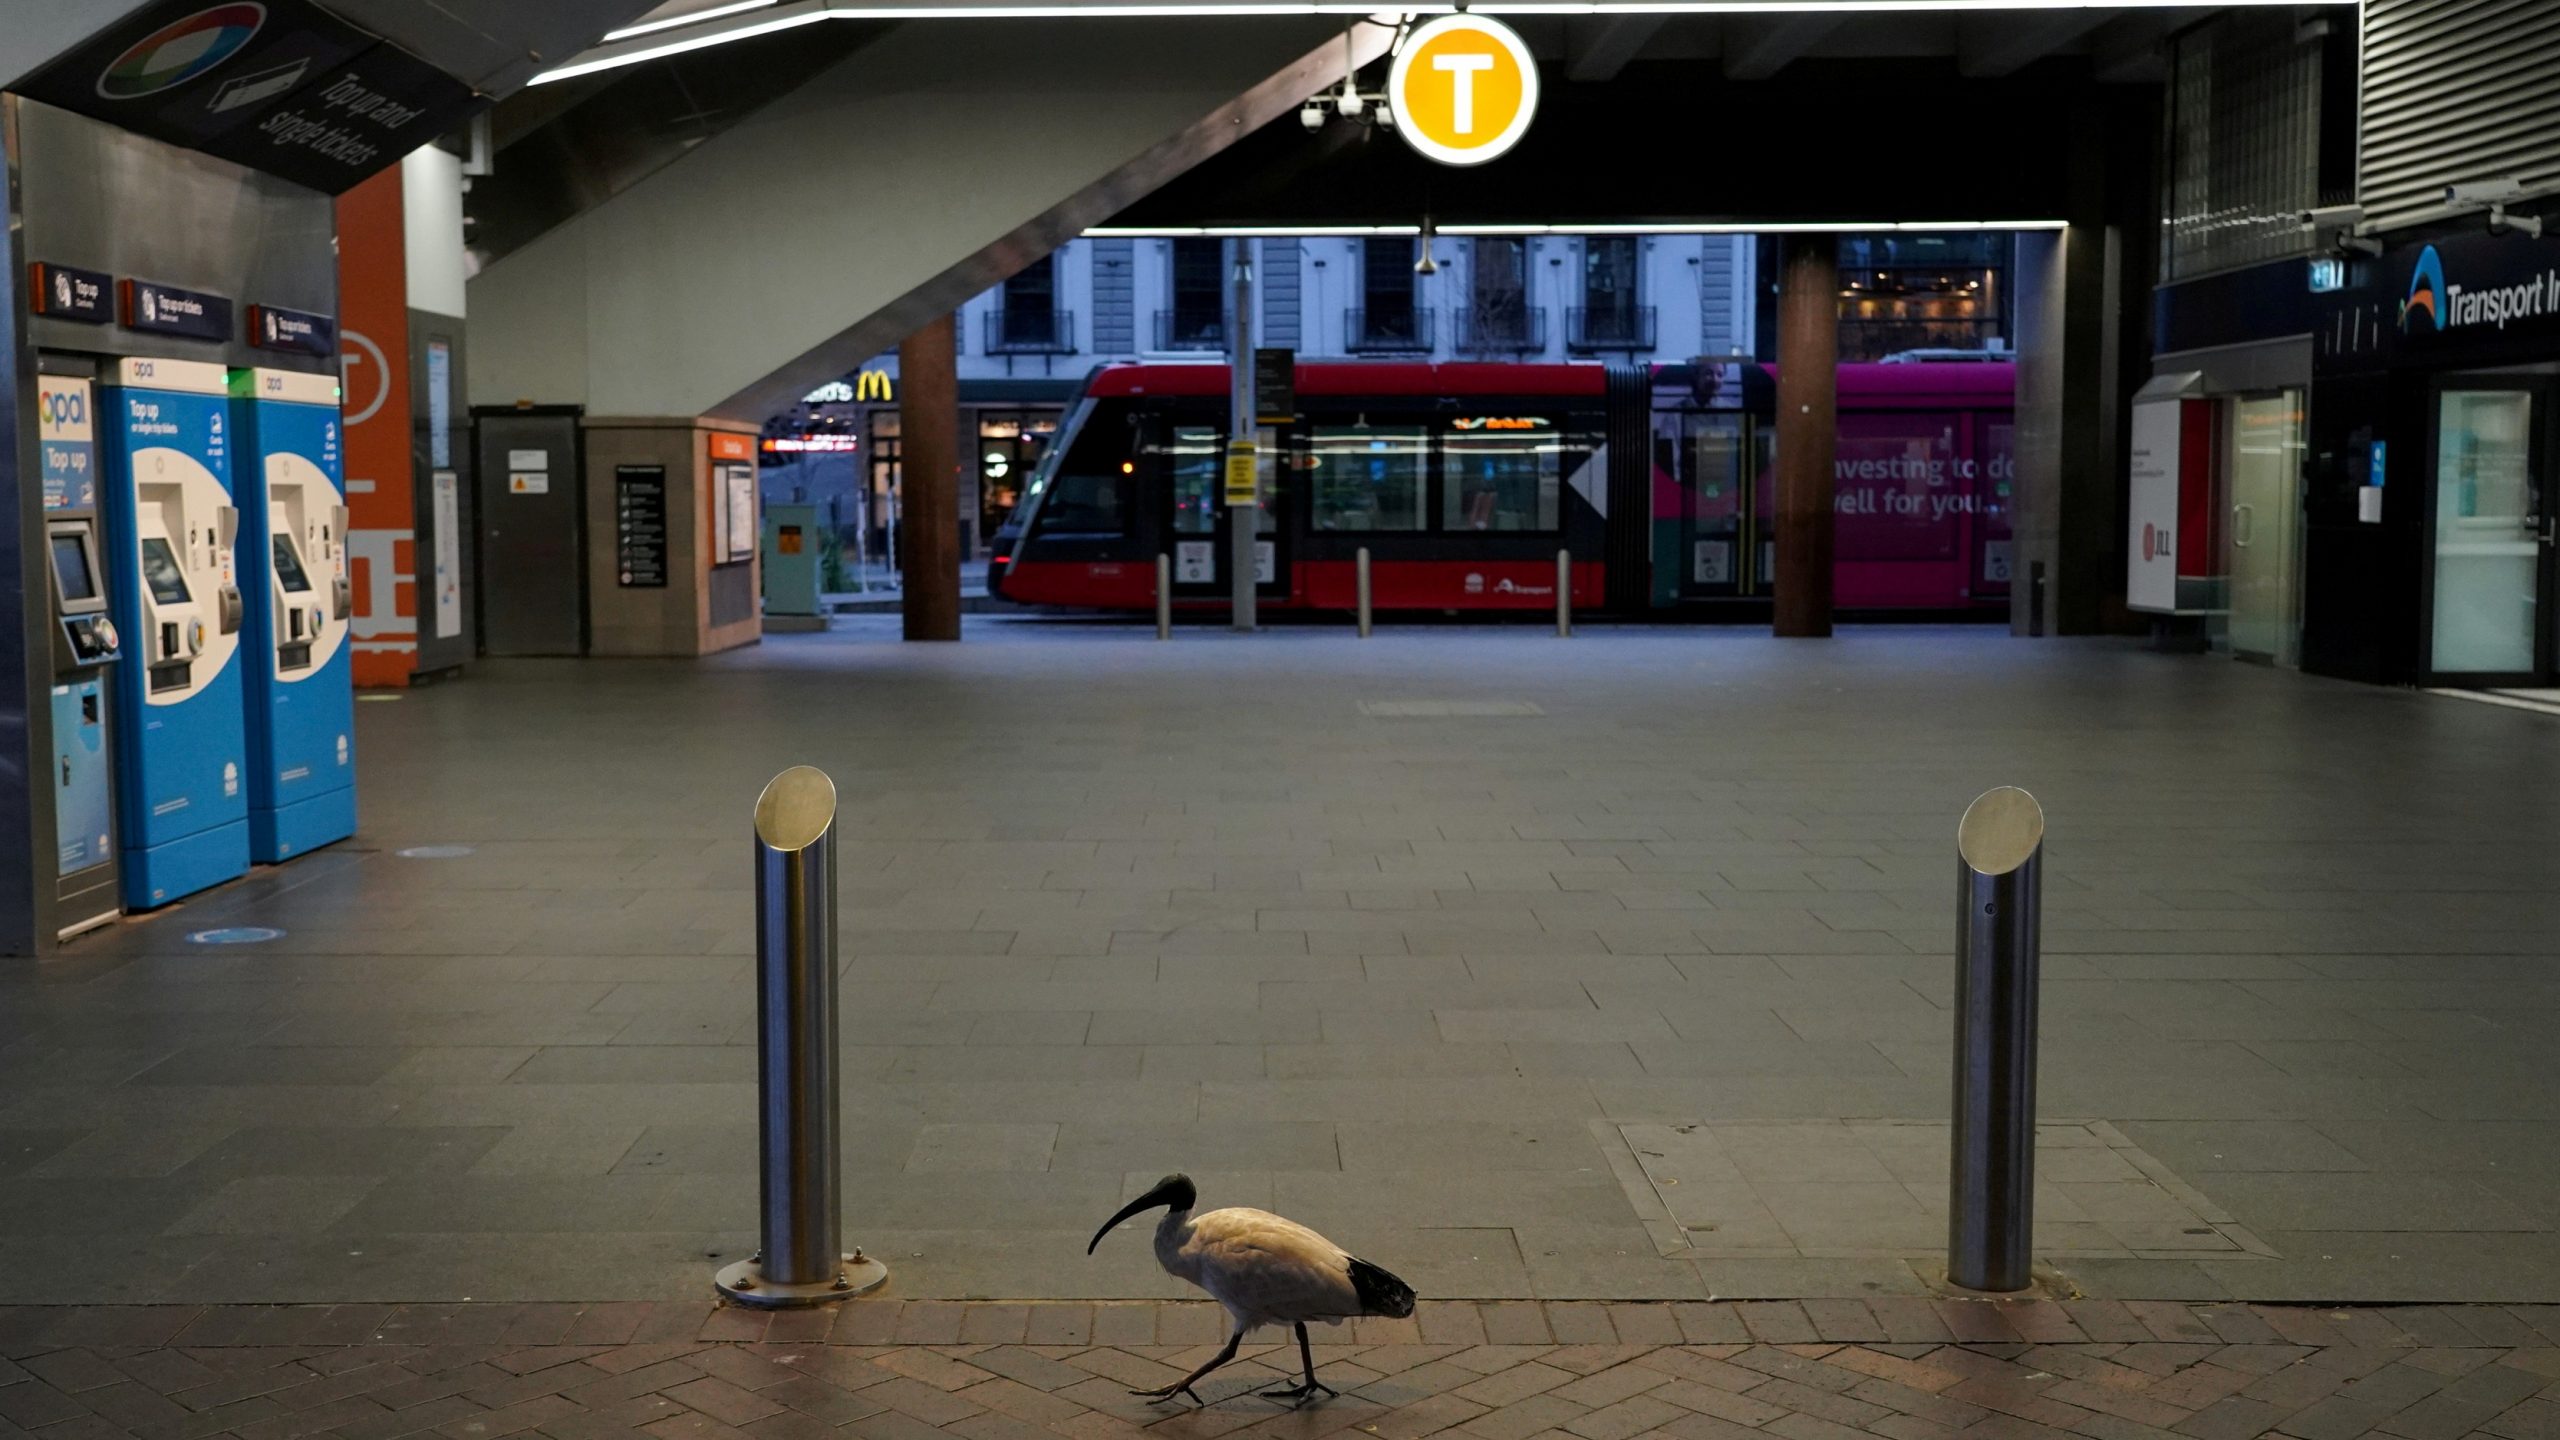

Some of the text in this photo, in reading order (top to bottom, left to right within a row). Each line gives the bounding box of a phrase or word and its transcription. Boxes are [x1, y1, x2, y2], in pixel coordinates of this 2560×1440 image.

[319, 73, 426, 129] Top up and
[1432, 53, 1494, 134] T
[259, 109, 378, 165] single tickets
[75, 279, 99, 300] Top up
[2446, 272, 2544, 330] Transport
[134, 360, 154, 381] opal
[40, 387, 86, 433] opal
[130, 399, 159, 421] Top up
[47, 447, 87, 474] Top up
[1834, 455, 1944, 487] vesting
[1953, 457, 1979, 479] to
[1883, 488, 1924, 514] for
